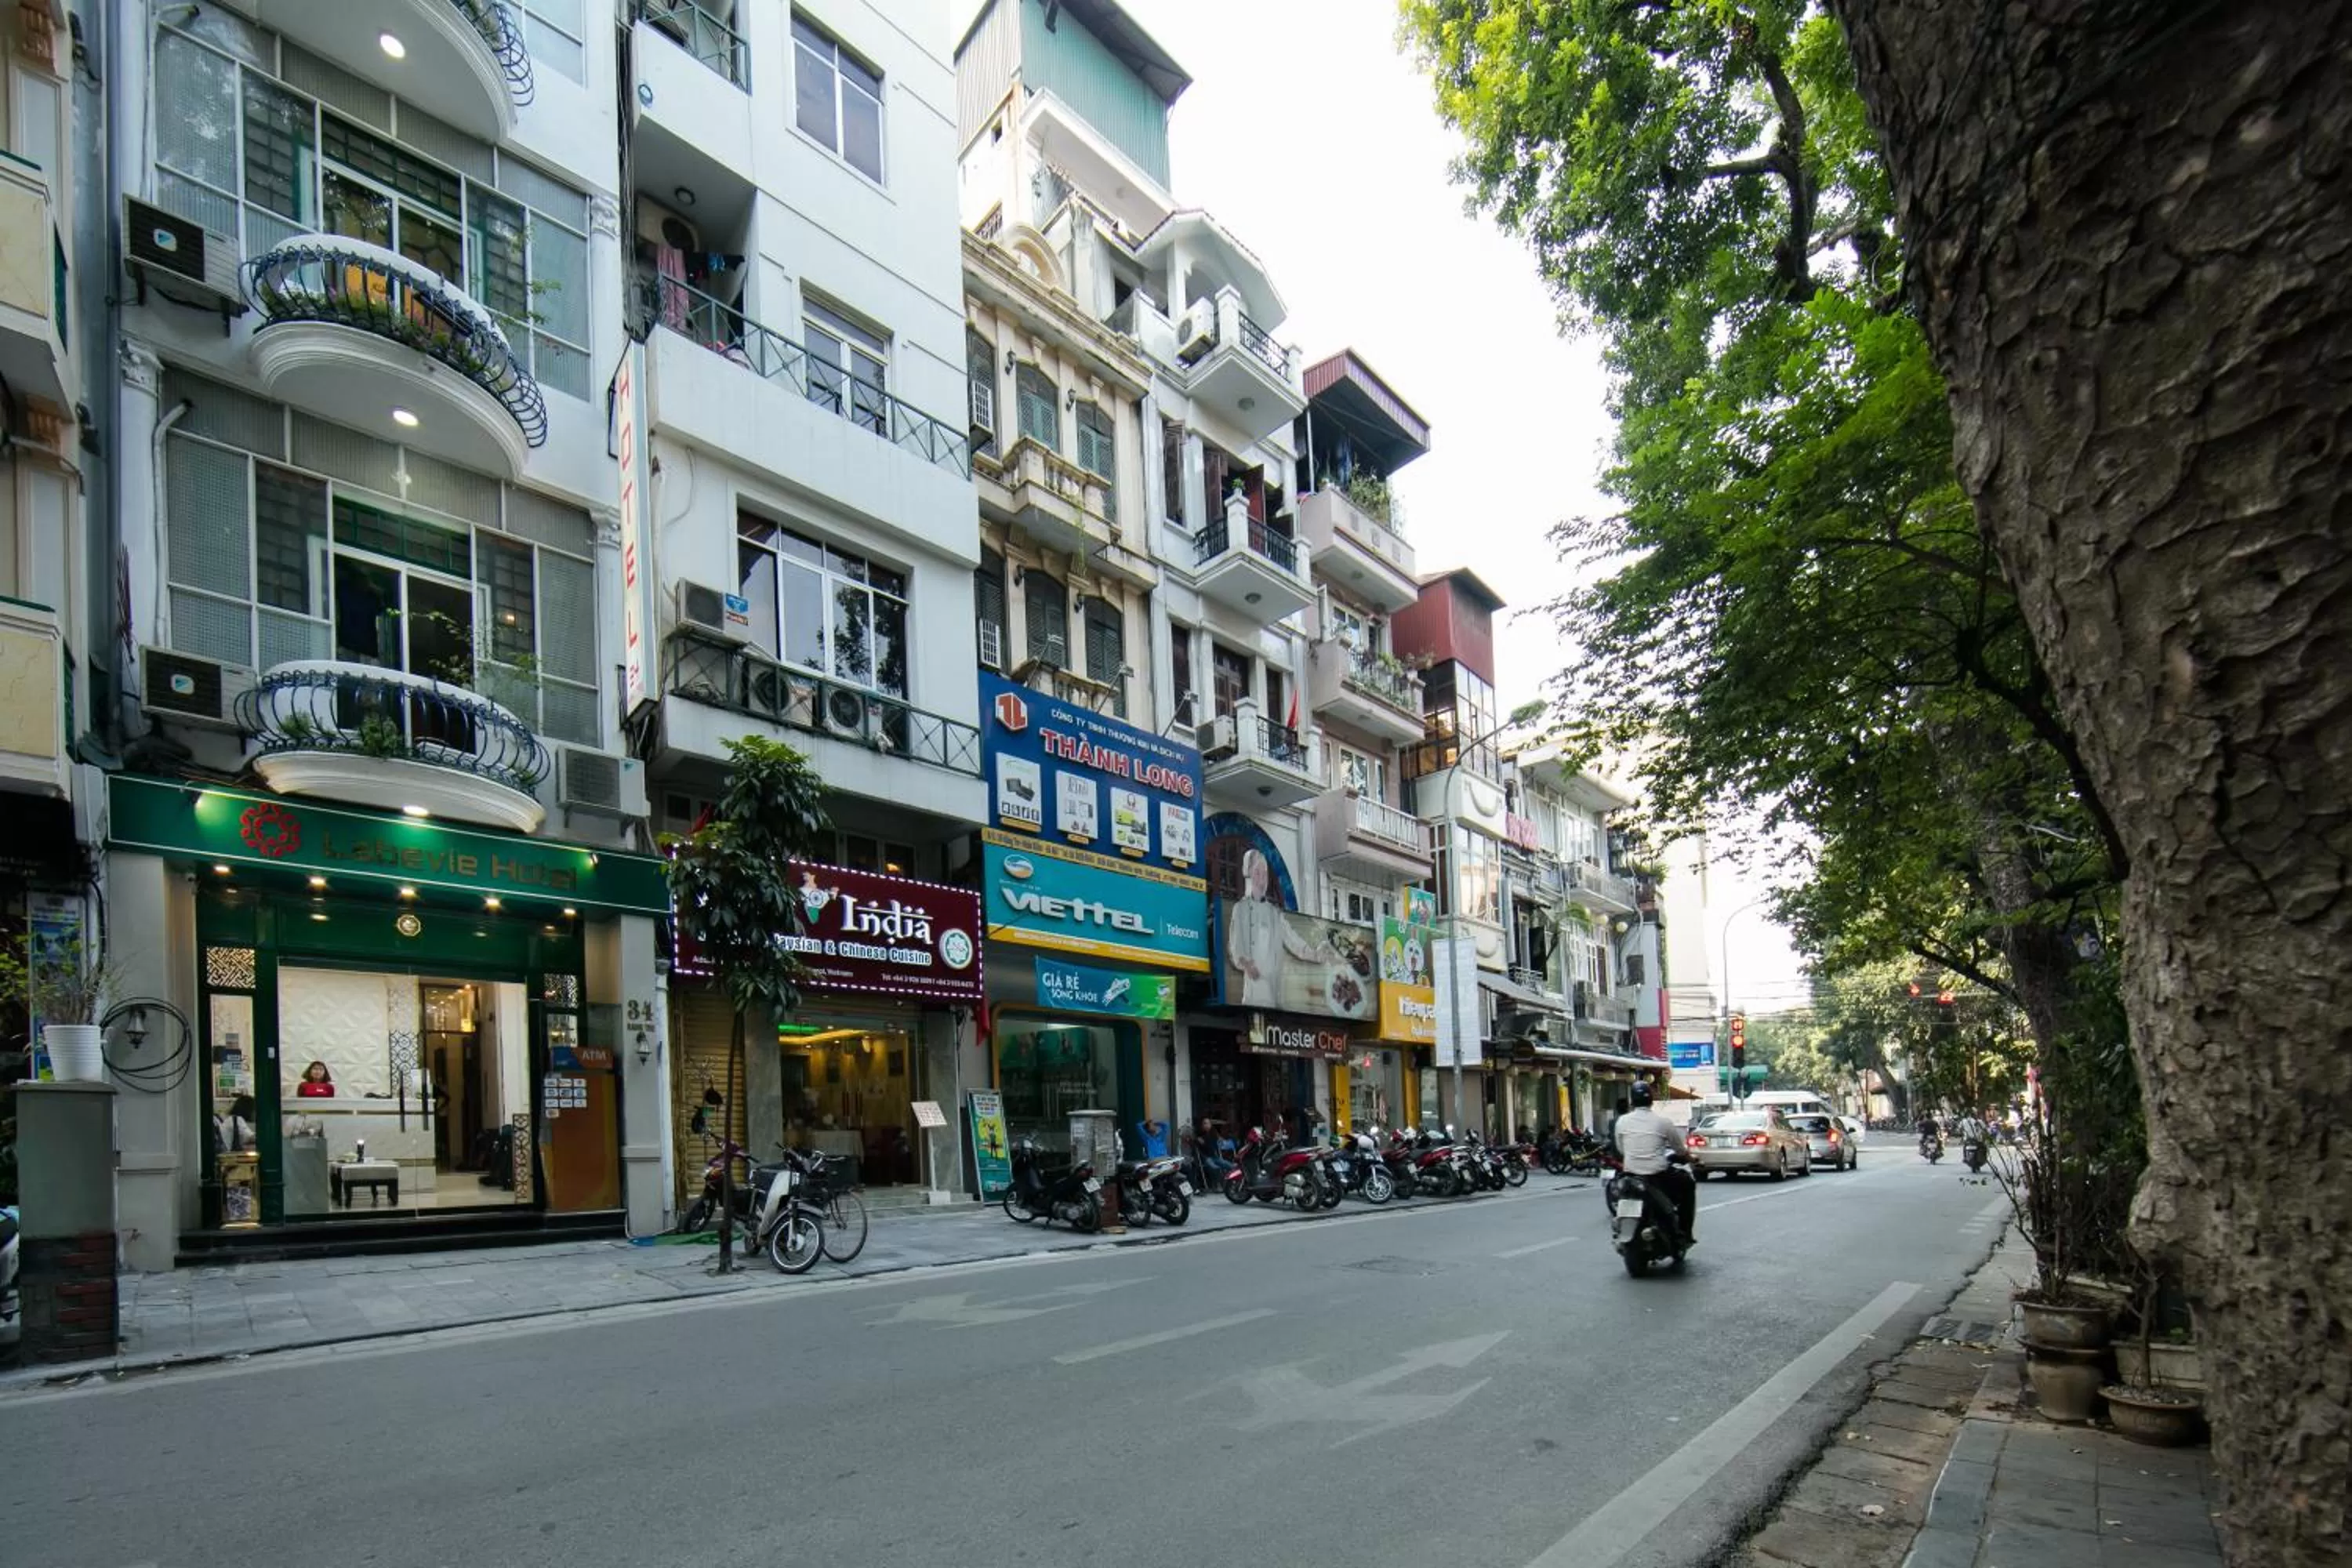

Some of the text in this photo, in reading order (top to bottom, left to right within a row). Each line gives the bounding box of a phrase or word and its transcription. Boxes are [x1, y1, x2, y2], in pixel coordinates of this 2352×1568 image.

[619, 361, 638, 648] HOTEL
[1040, 727, 1195, 797] THÀNH LONG
[1167, 924, 1200, 940] Telecom
[825, 941, 837, 956] &
[840, 943, 887, 960] Chinese
[890, 948, 933, 966] Cuisine
[628, 1000, 654, 1022] 34
[1317, 1030, 1348, 1052] Chef
[582, 1049, 607, 1062] ATM
